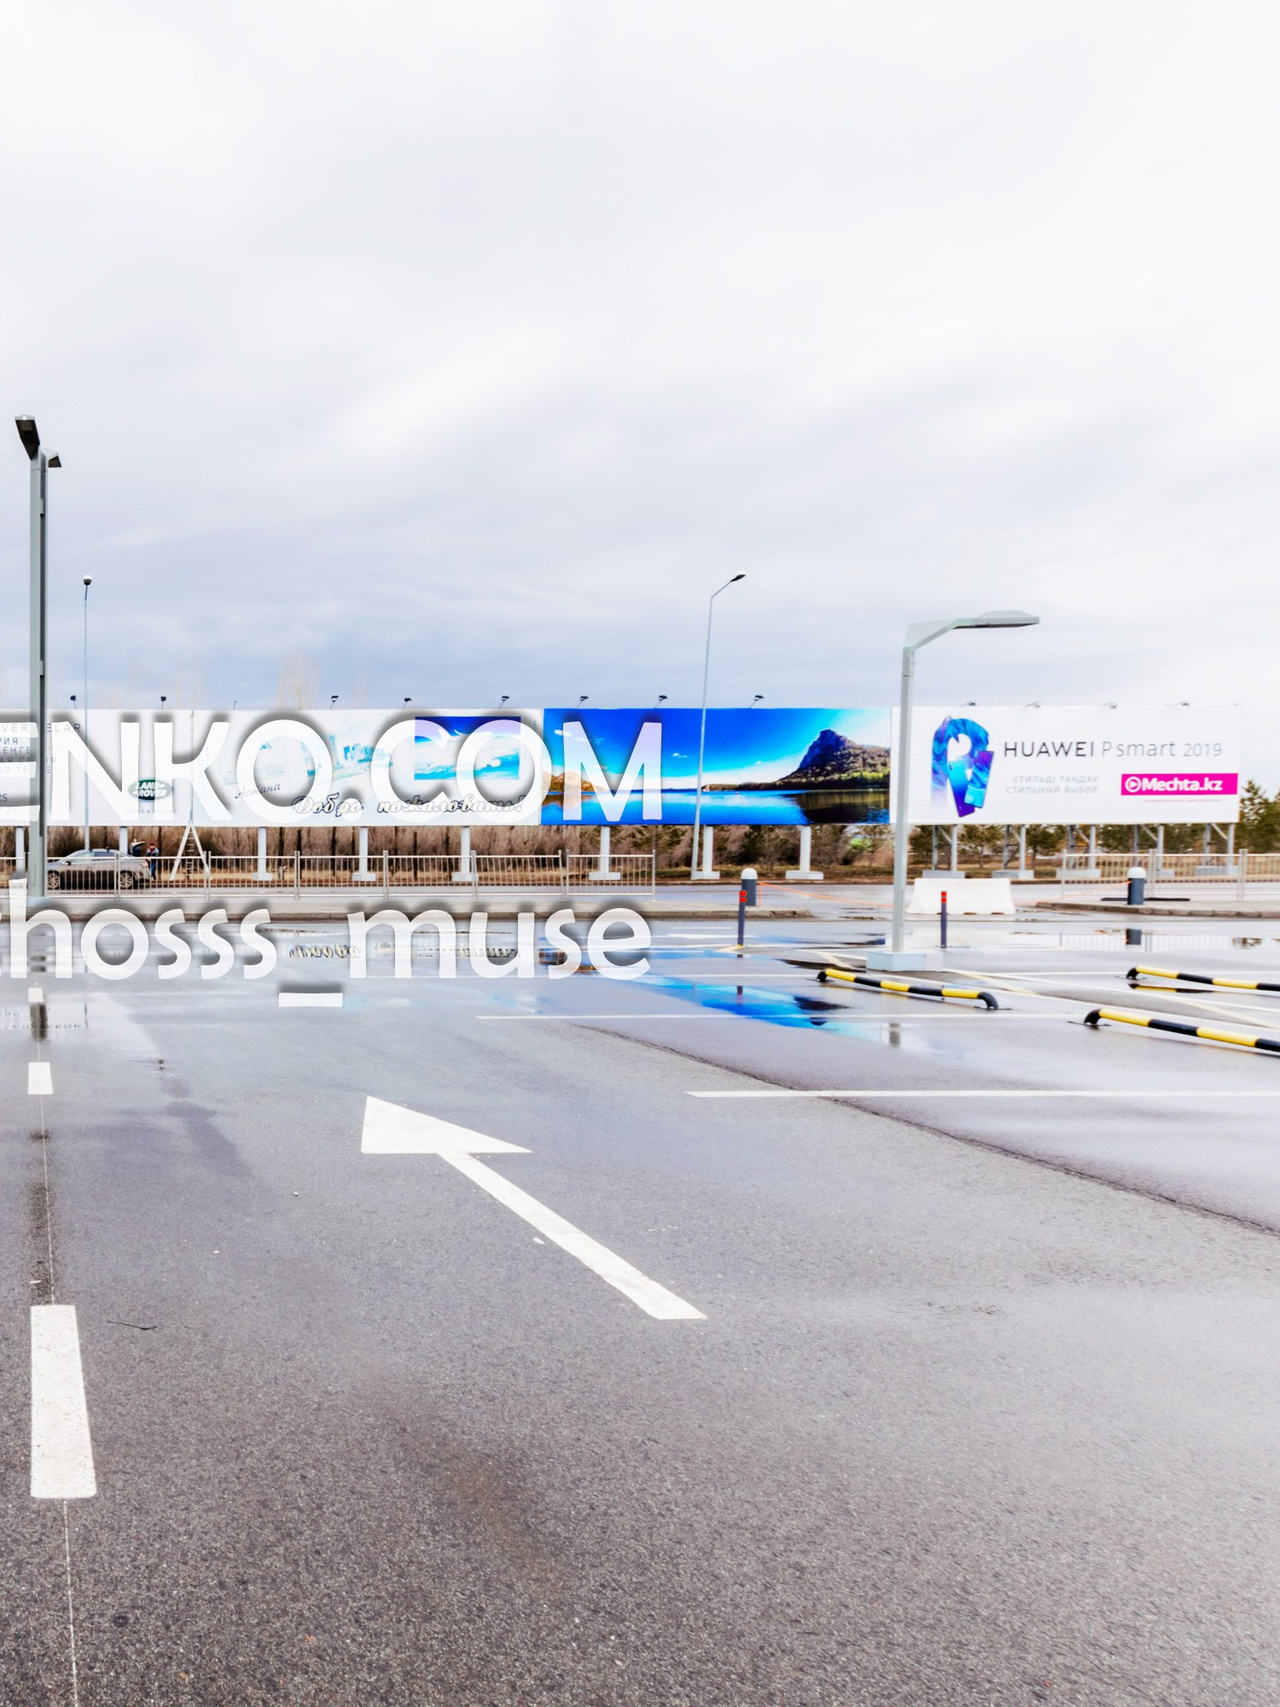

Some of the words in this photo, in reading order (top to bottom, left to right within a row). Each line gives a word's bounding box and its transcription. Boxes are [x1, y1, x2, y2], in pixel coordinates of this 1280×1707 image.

[1004, 741, 1095, 758] HUAWEI
[1102, 741, 1112, 758] P
[1117, 742, 1176, 758] smart
[1183, 743, 1222, 758] 2019
[1142, 776, 1222, 793] Mechta.kz
[291, 792, 364, 818] Добро
